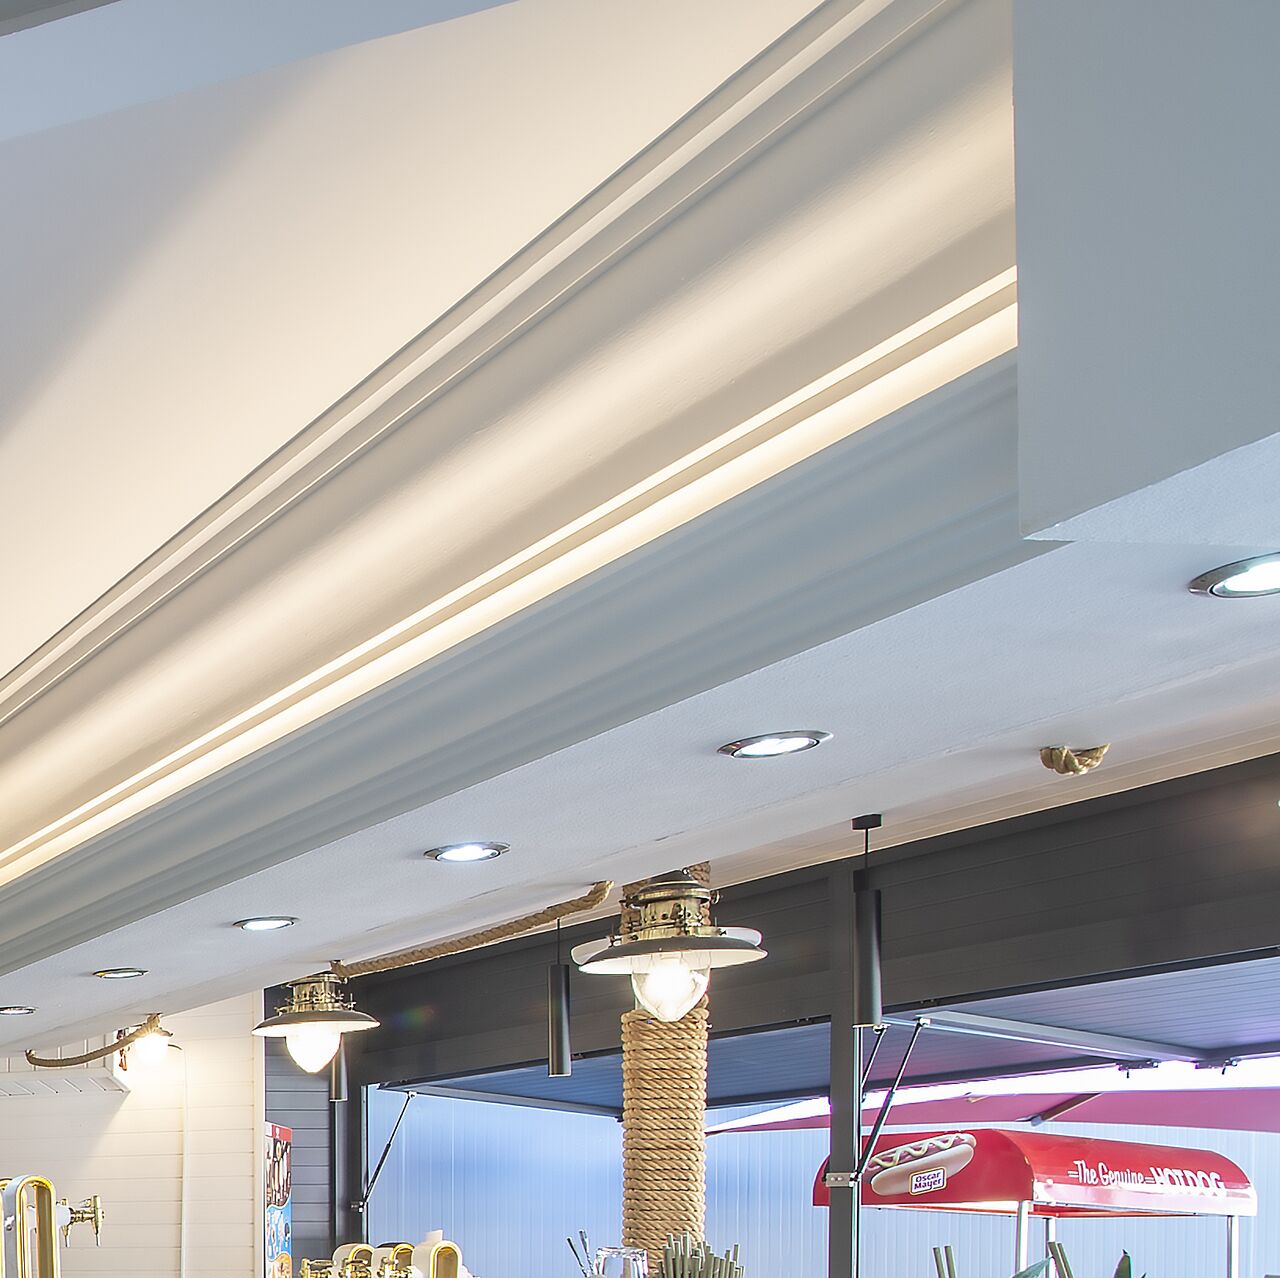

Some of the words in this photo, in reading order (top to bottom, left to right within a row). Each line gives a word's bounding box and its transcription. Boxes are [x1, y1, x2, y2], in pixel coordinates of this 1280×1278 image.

[915, 1171, 941, 1183] Oscar
[1073, 1160, 1099, 1185] The
[1098, 1162, 1145, 1186] Genuine
[914, 1178, 942, 1191] Mayer
